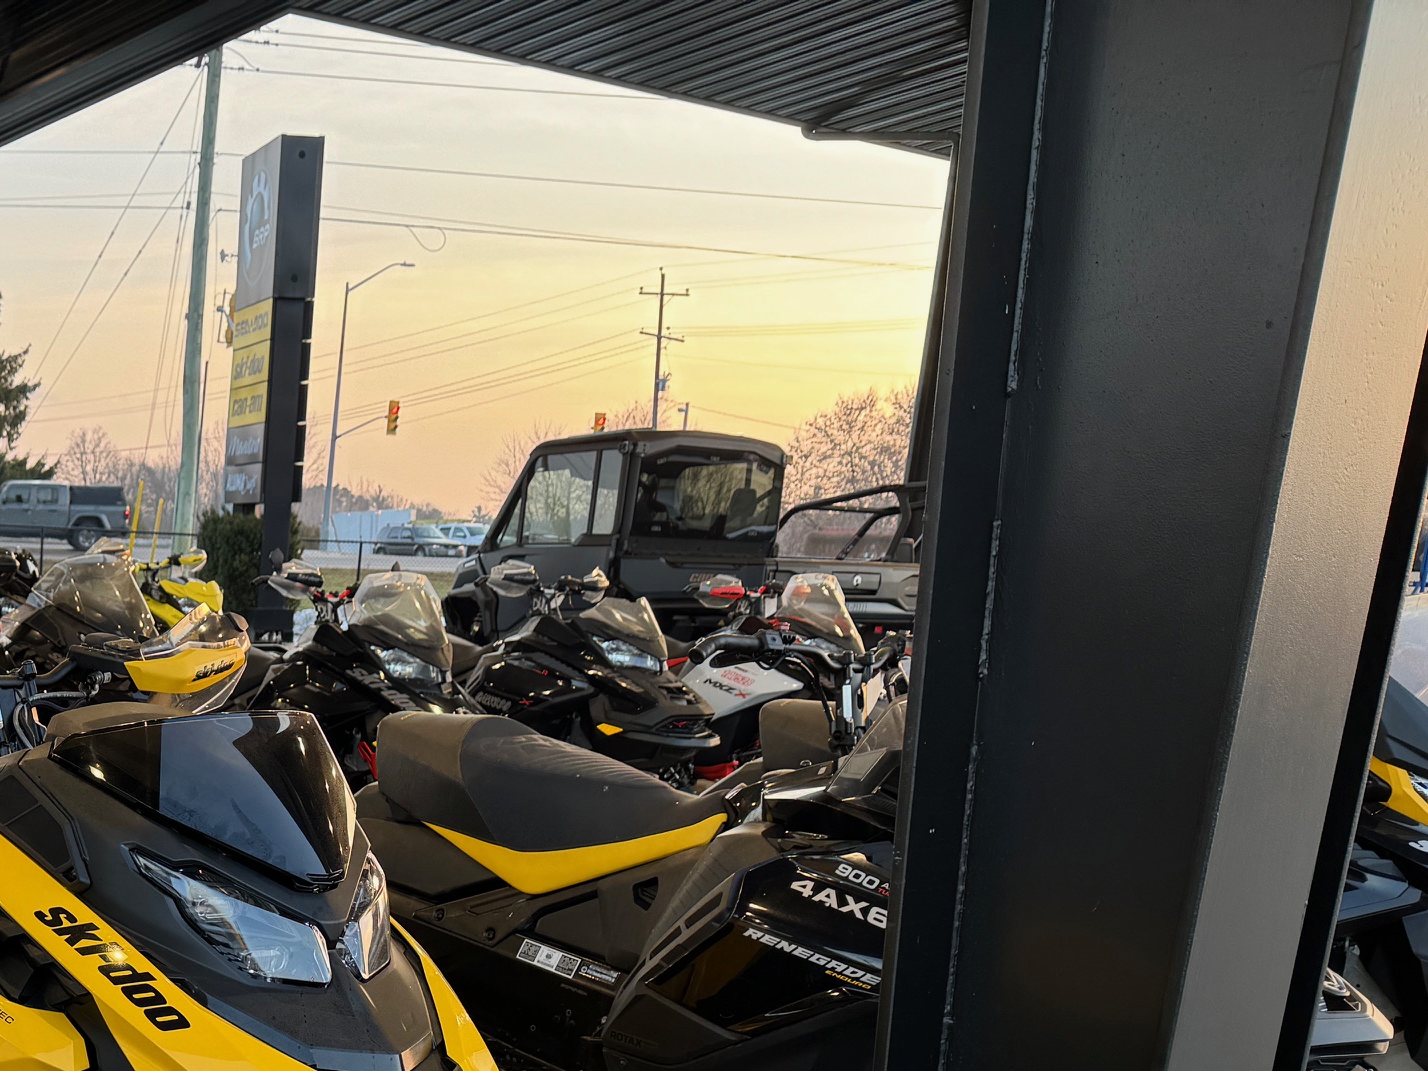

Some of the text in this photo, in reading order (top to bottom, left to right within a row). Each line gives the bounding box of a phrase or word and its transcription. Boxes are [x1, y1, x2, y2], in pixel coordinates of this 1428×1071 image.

[703, 678, 736, 694] MXZ
[835, 863, 880, 889] 900
[34, 905, 191, 1032] ski-doo
[743, 927, 882, 986] RENEGADE
[824, 969, 872, 990] ENDURO
